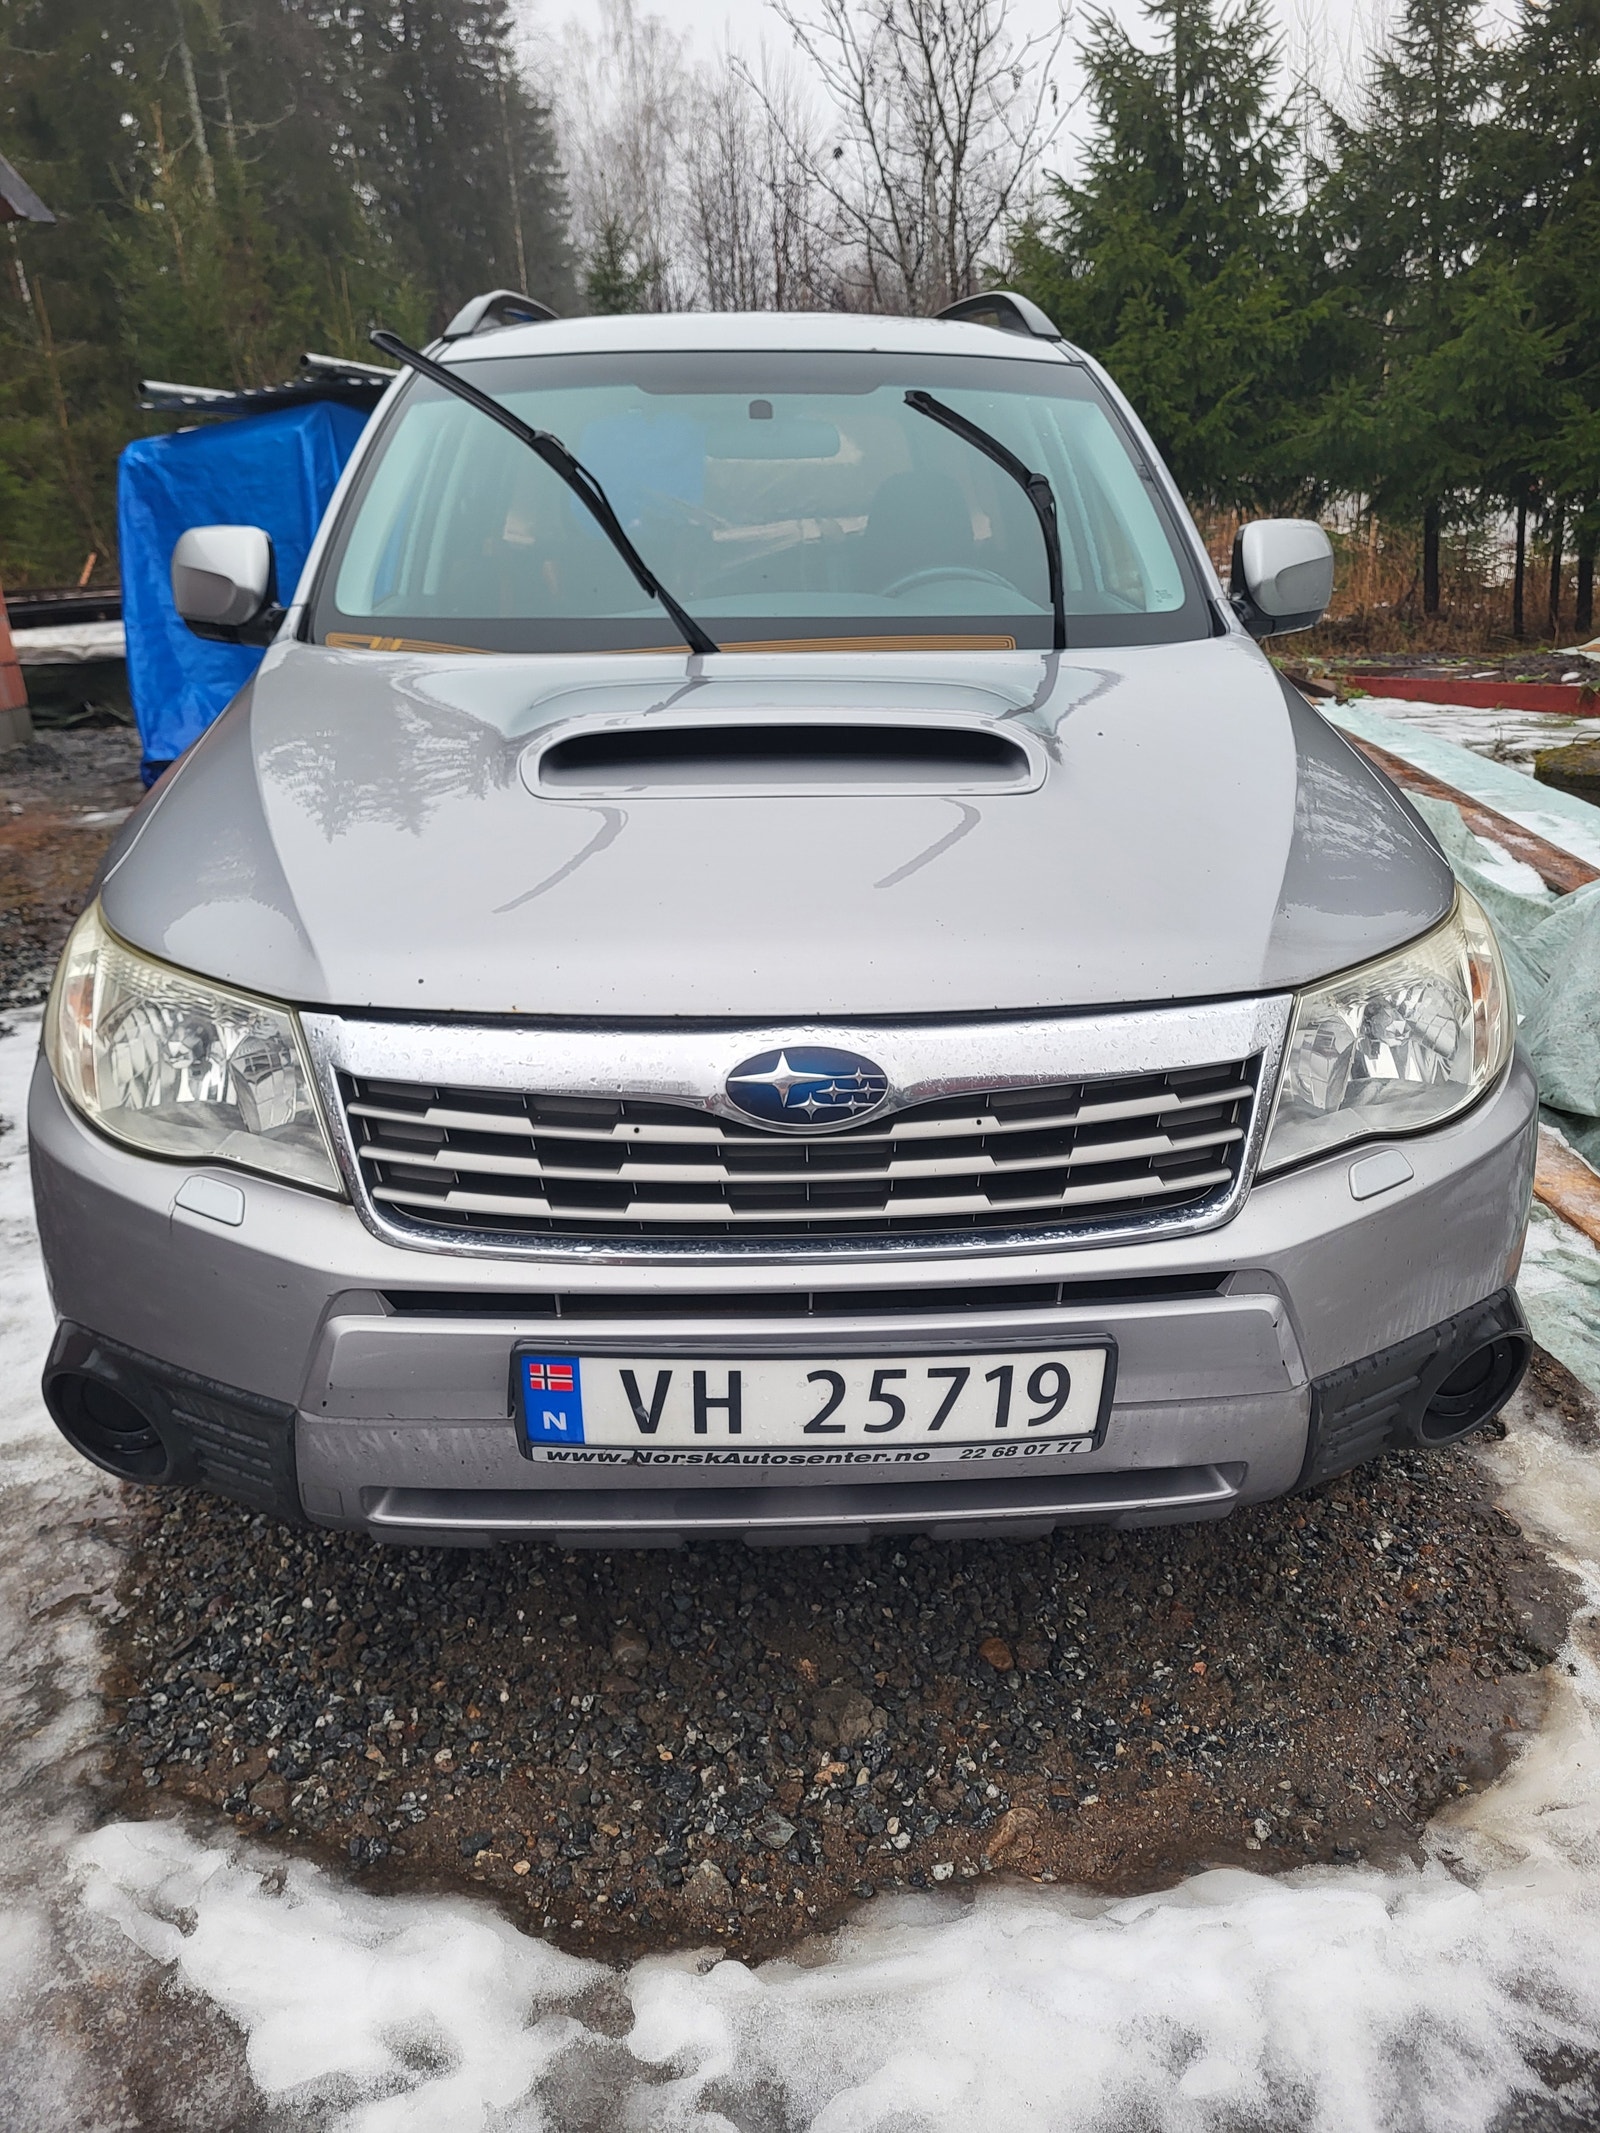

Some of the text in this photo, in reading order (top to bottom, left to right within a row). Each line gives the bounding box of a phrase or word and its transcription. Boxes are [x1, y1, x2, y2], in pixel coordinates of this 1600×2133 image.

[618, 1361, 1072, 1435] VH 25719
[542, 1410, 568, 1431] N
[546, 1440, 1083, 1465] www.NorskAutosenter.no 22 68 07 77
